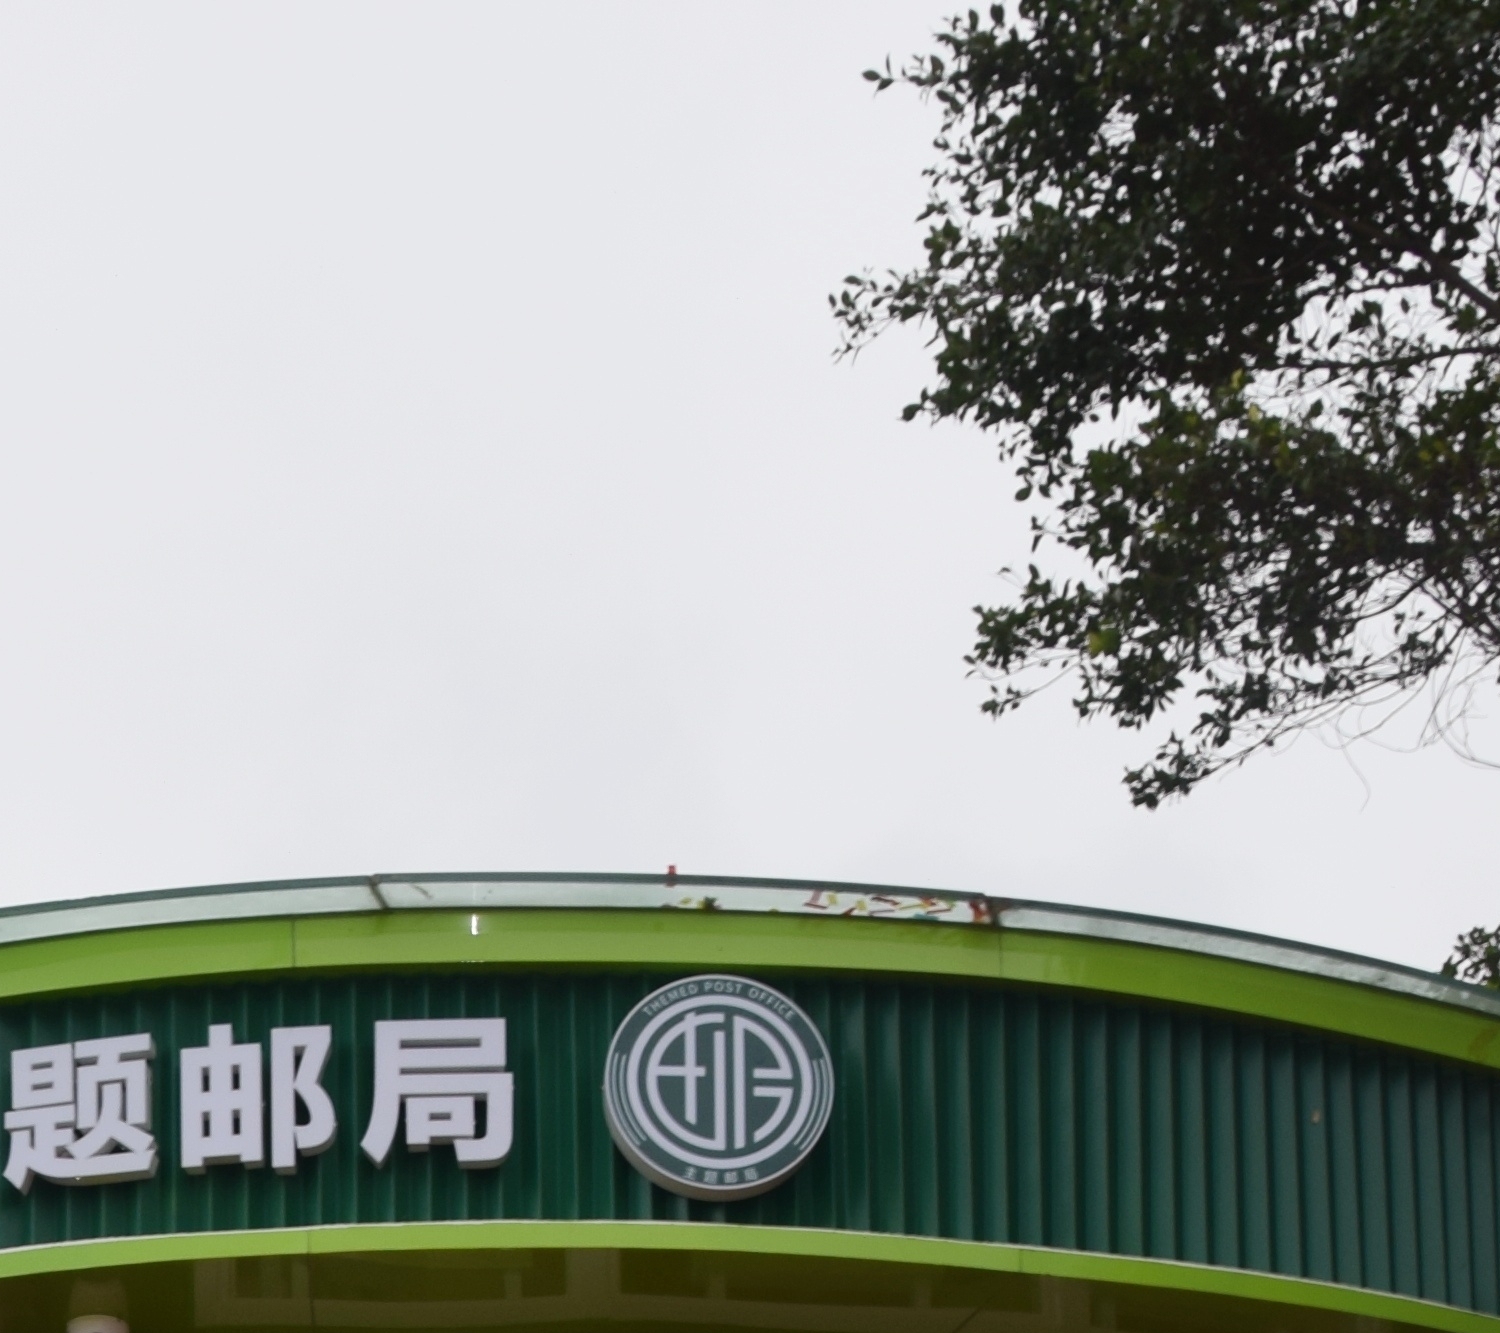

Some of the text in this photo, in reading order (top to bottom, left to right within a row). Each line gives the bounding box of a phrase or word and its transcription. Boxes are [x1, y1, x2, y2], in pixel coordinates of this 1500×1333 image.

[642, 981, 796, 1022] THEMED POST OFFICE
